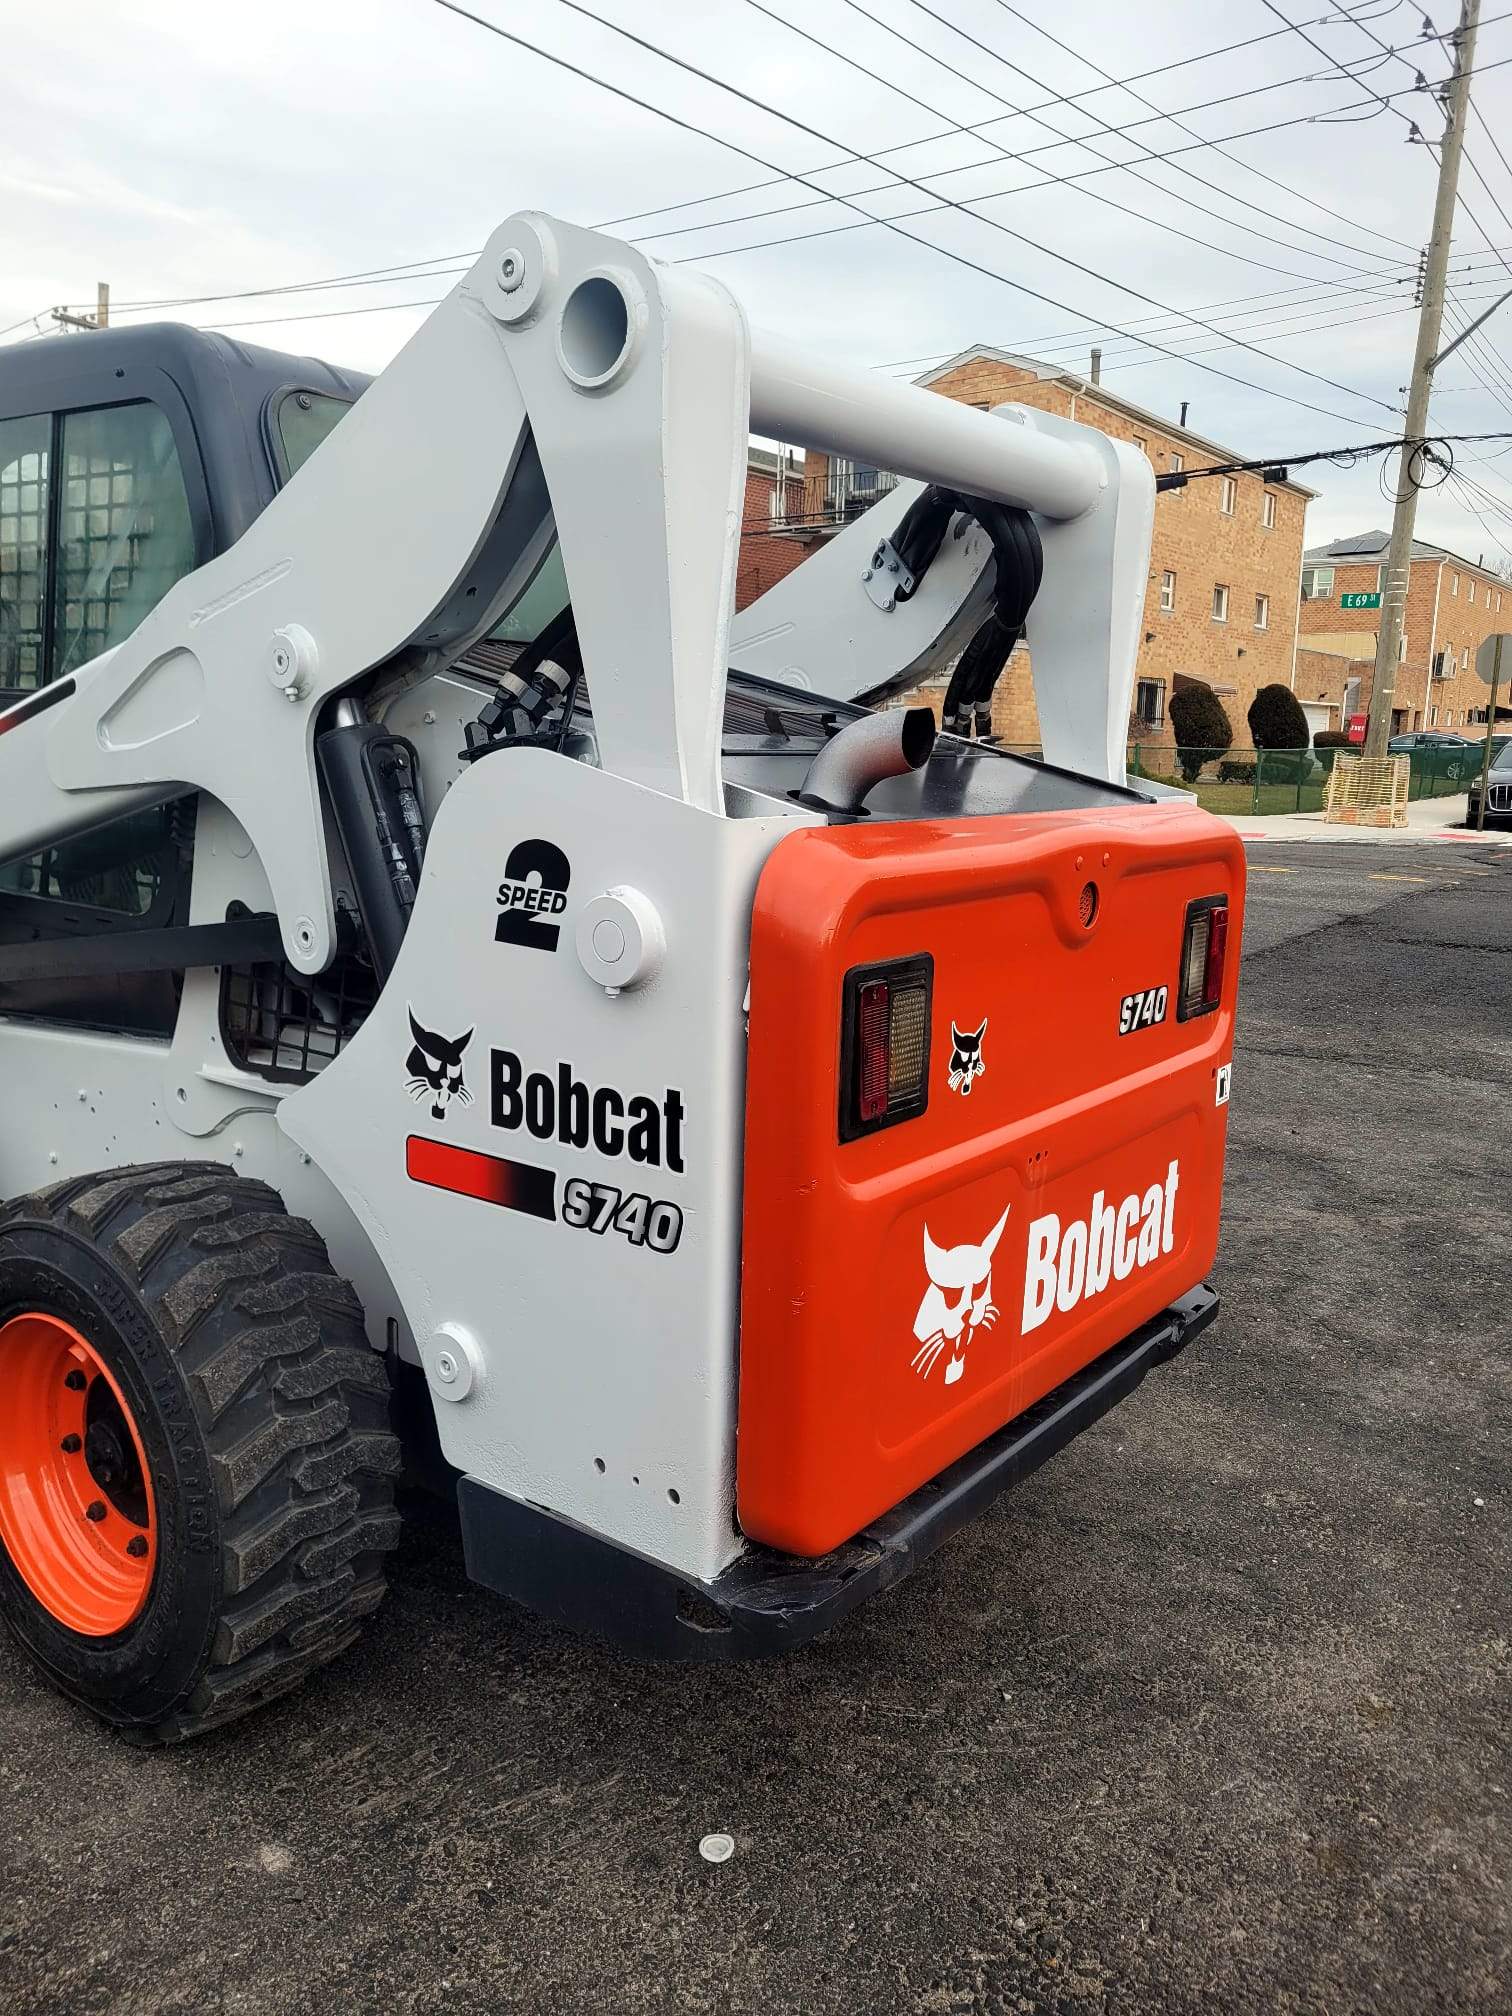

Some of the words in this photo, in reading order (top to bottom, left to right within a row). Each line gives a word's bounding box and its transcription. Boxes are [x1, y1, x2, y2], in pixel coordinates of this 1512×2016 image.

[1347, 595, 1354, 607] E
[1355, 594, 1368, 607] 69
[494, 838, 572, 953] 2
[496, 883, 567, 914] SPEED
[1119, 986, 1168, 1034] S740
[490, 1048, 685, 1174] Bobcat
[562, 1178, 684, 1254] S740
[1021, 1159, 1181, 1336] Bobcat
